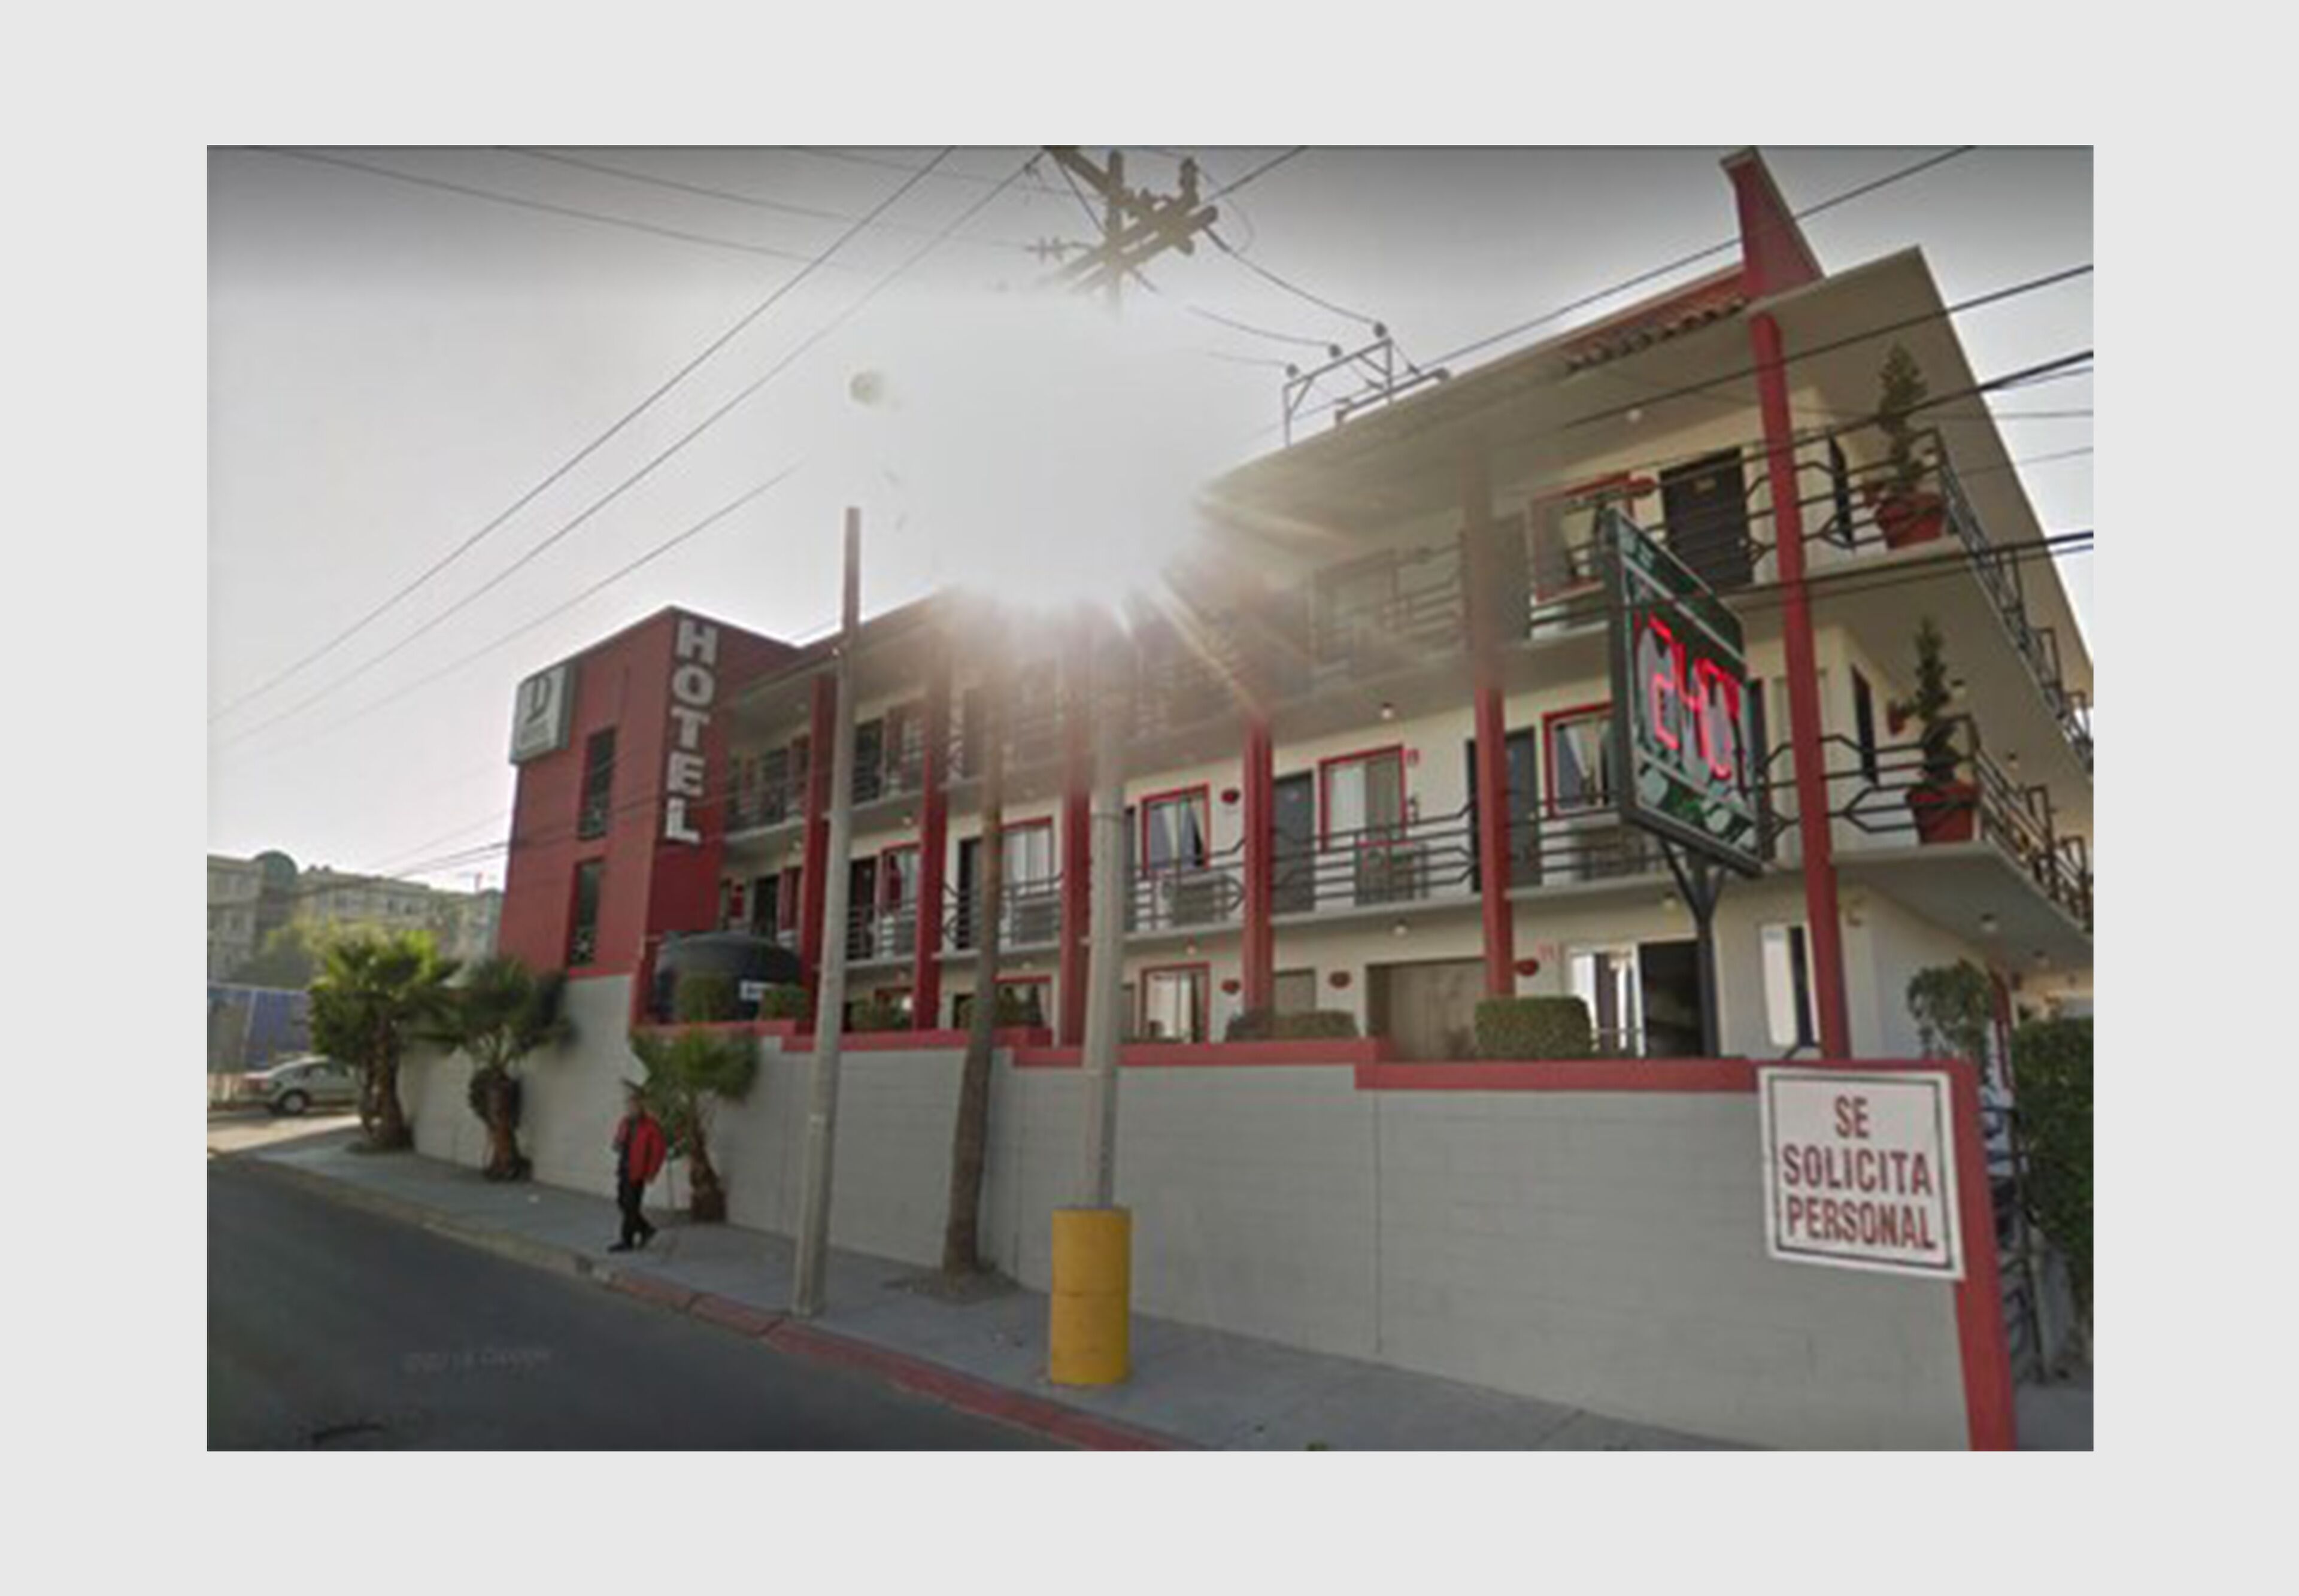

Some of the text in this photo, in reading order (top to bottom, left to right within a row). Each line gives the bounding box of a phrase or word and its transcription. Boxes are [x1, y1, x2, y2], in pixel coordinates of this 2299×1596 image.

[666, 619, 718, 843] HOTEL
[1834, 1095, 1869, 1138] SE
[1782, 1144, 1932, 1195] SOLICITA
[1786, 1194, 1936, 1249] PERSONAL
